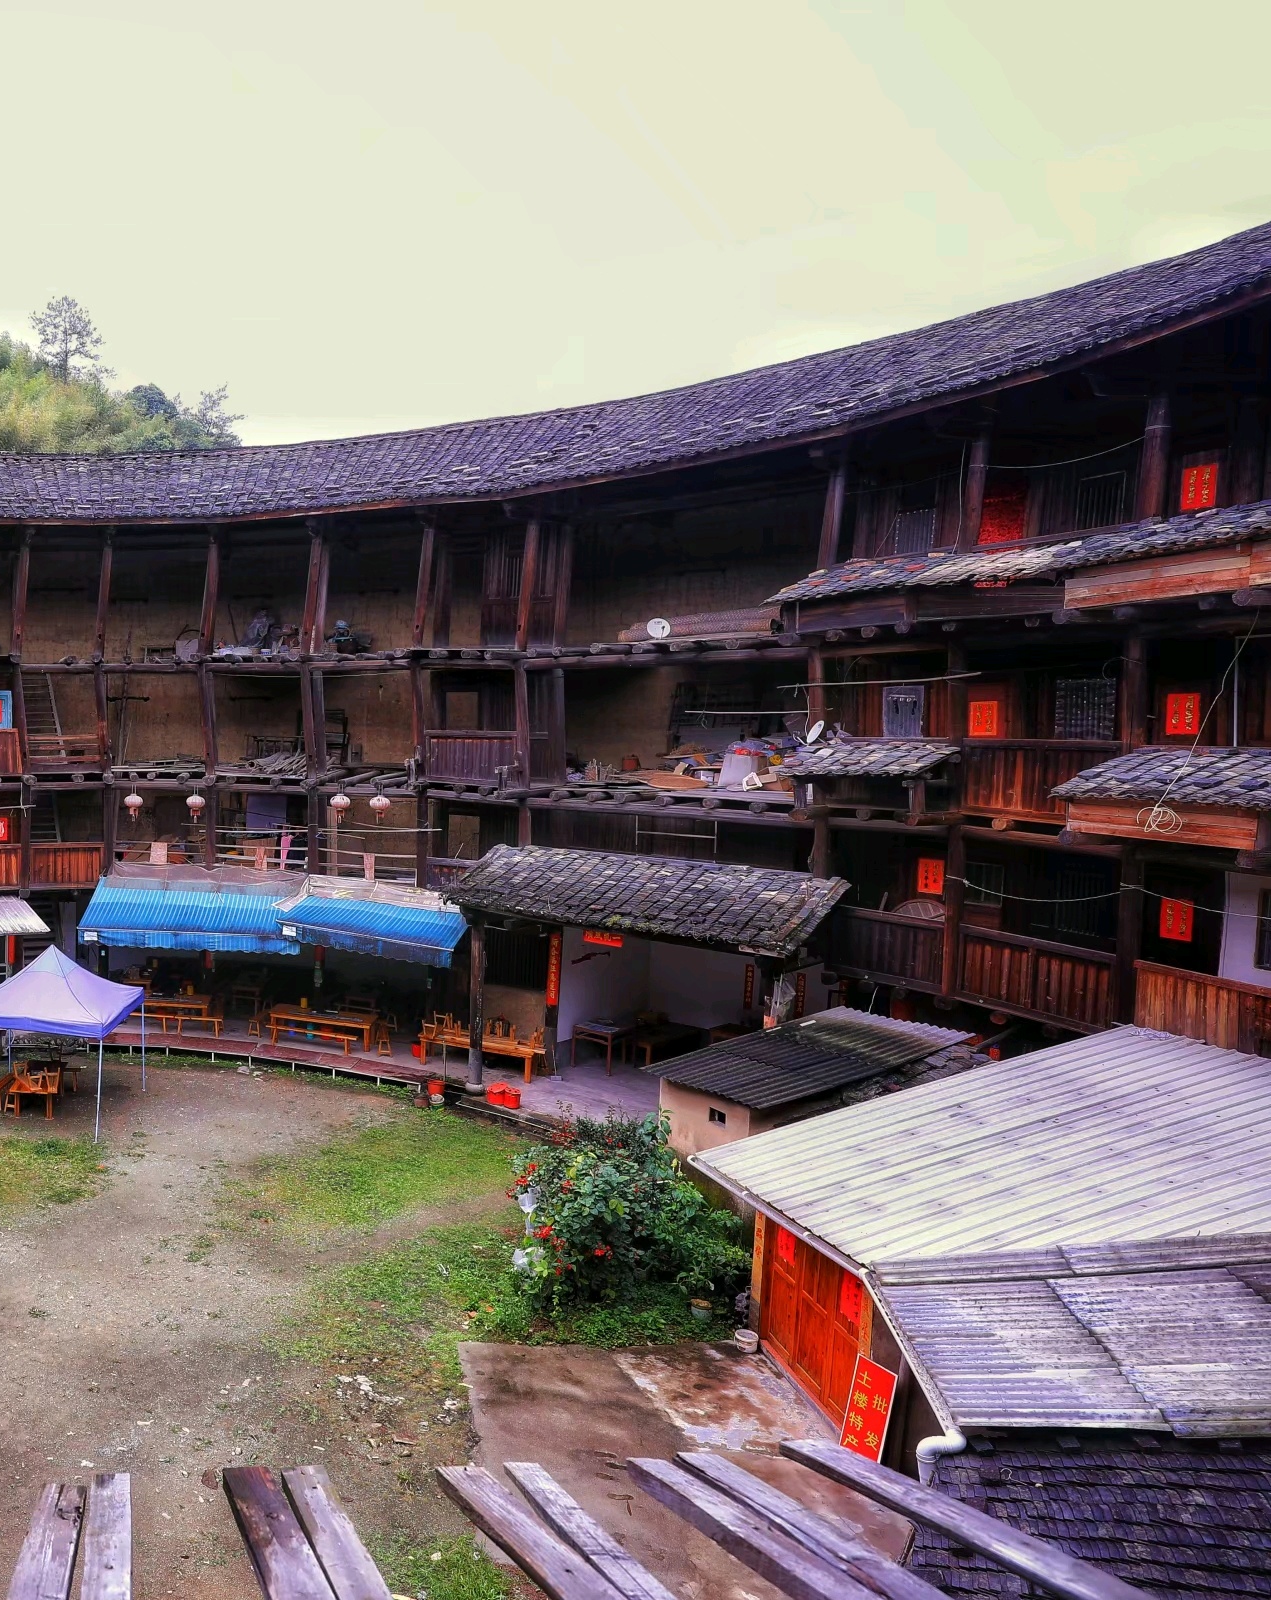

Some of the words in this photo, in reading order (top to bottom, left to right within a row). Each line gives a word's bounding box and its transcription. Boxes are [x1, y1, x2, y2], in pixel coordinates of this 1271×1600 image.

[843, 1371, 872, 1449] 土楼特产
[864, 1393, 888, 1451] 批发
